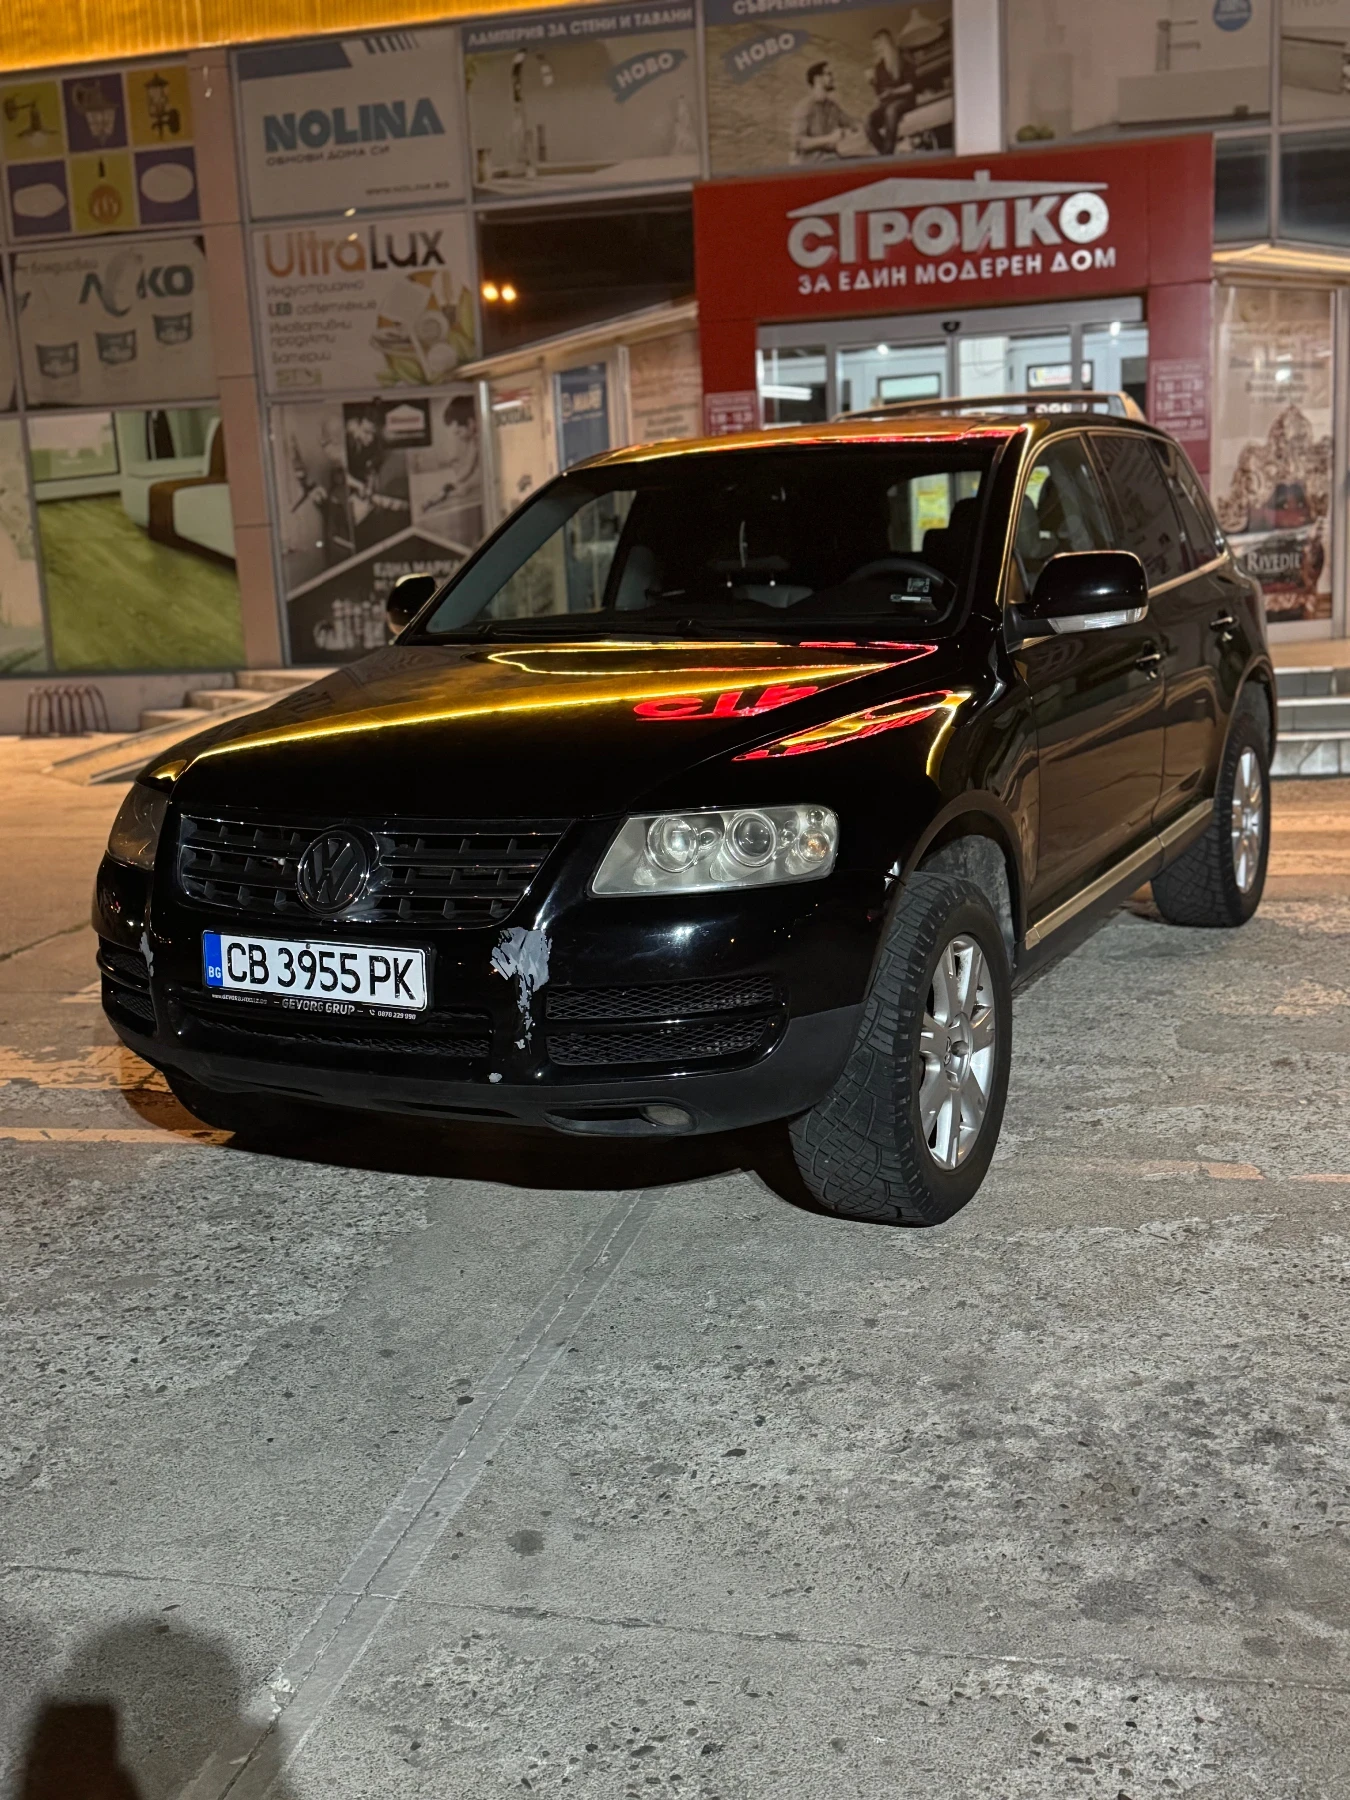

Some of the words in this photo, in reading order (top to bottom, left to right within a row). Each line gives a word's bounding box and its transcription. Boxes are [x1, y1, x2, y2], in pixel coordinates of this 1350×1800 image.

[467, 25, 546, 46] ЛАМПЕРИЯ
[549, 23, 568, 38] ЗА
[570, 18, 617, 35] СТЕНИ
[619, 16, 632, 28] И
[634, 8, 694, 28] ТАВАНИ
[616, 52, 674, 88] НОВО
[733, 33, 796, 71] НОВО
[263, 97, 446, 153] NOLINA
[265, 153, 324, 167] ОБНОВИ
[326, 148, 366, 162] ДОМА
[797, 273, 832, 295] ЗА
[838, 266, 907, 292] ЕДИН
[914, 252, 1043, 285] МОДЕРЕН
[1050, 247, 1117, 273] ДОМ
[208, 965, 222, 979] BG
[226, 942, 270, 985] CB
[277, 947, 361, 994] 3955
[368, 955, 417, 1001] PK
[281, 998, 324, 1013] GEVORG
[324, 1002, 356, 1015] GRUP
